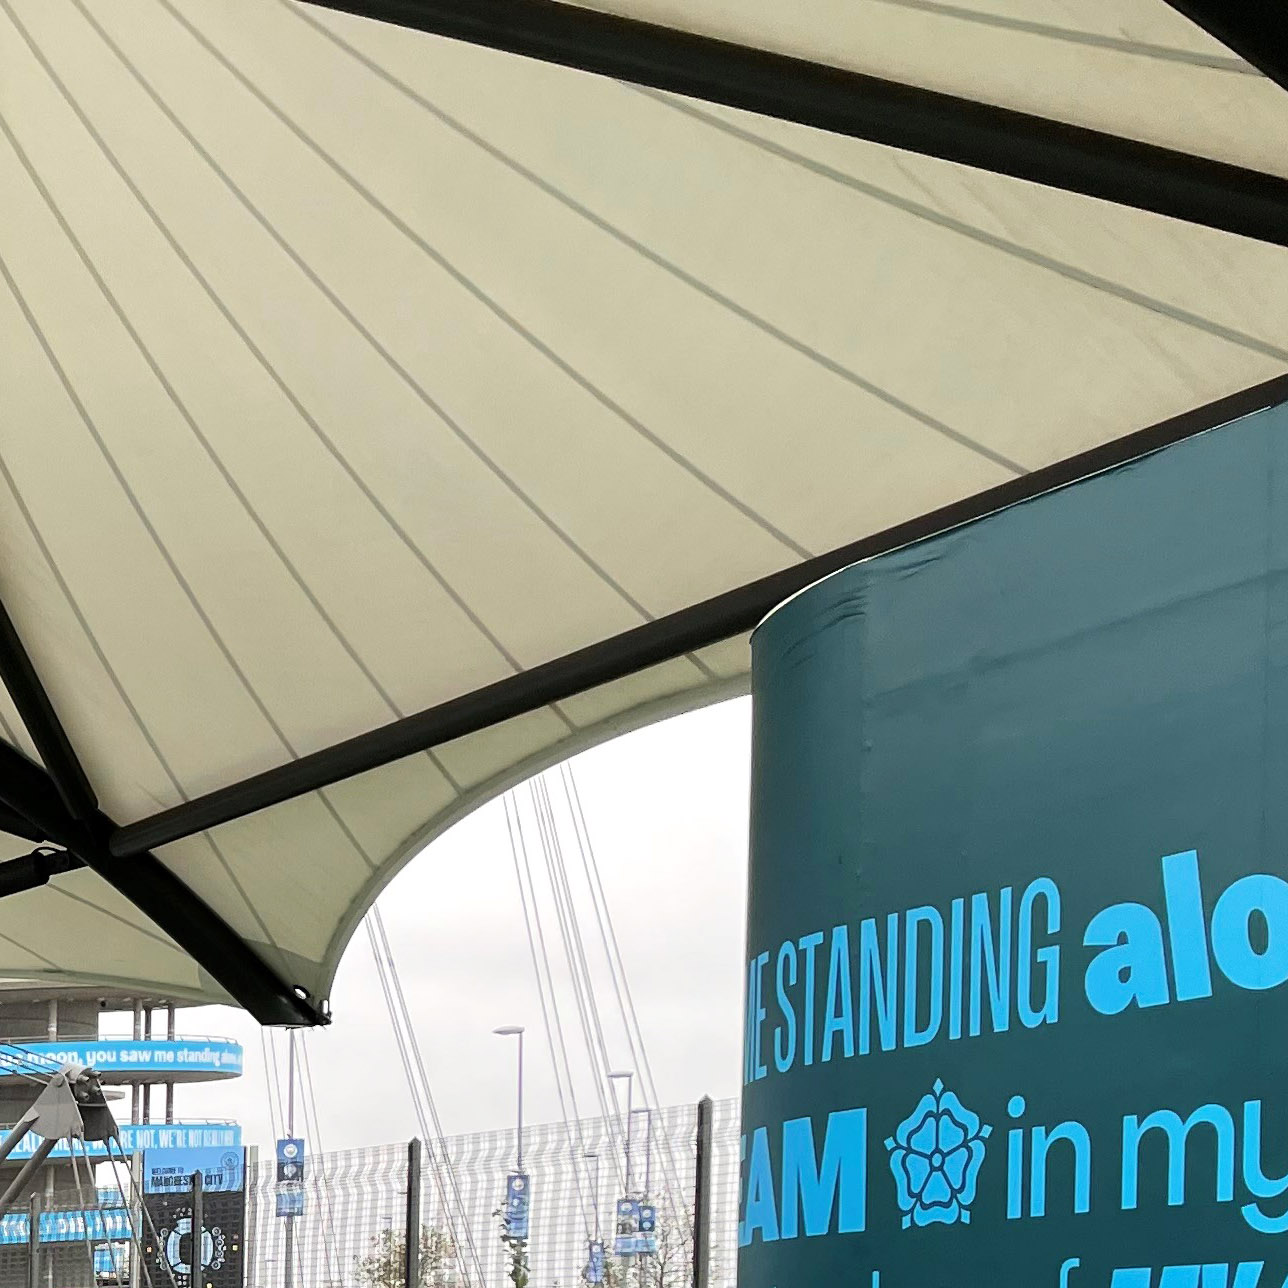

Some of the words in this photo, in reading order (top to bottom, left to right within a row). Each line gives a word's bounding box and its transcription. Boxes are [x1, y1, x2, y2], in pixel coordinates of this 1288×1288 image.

[774, 877, 1061, 1073] STANDING
[86, 1050, 116, 1067] you
[120, 1049, 152, 1063] saw
[154, 1049, 174, 1063] me
[177, 1047, 221, 1067] standing
[136, 1129, 158, 1149] NOT,
[1006, 1095, 1091, 1219] in
[1121, 1099, 1288, 1234] my
